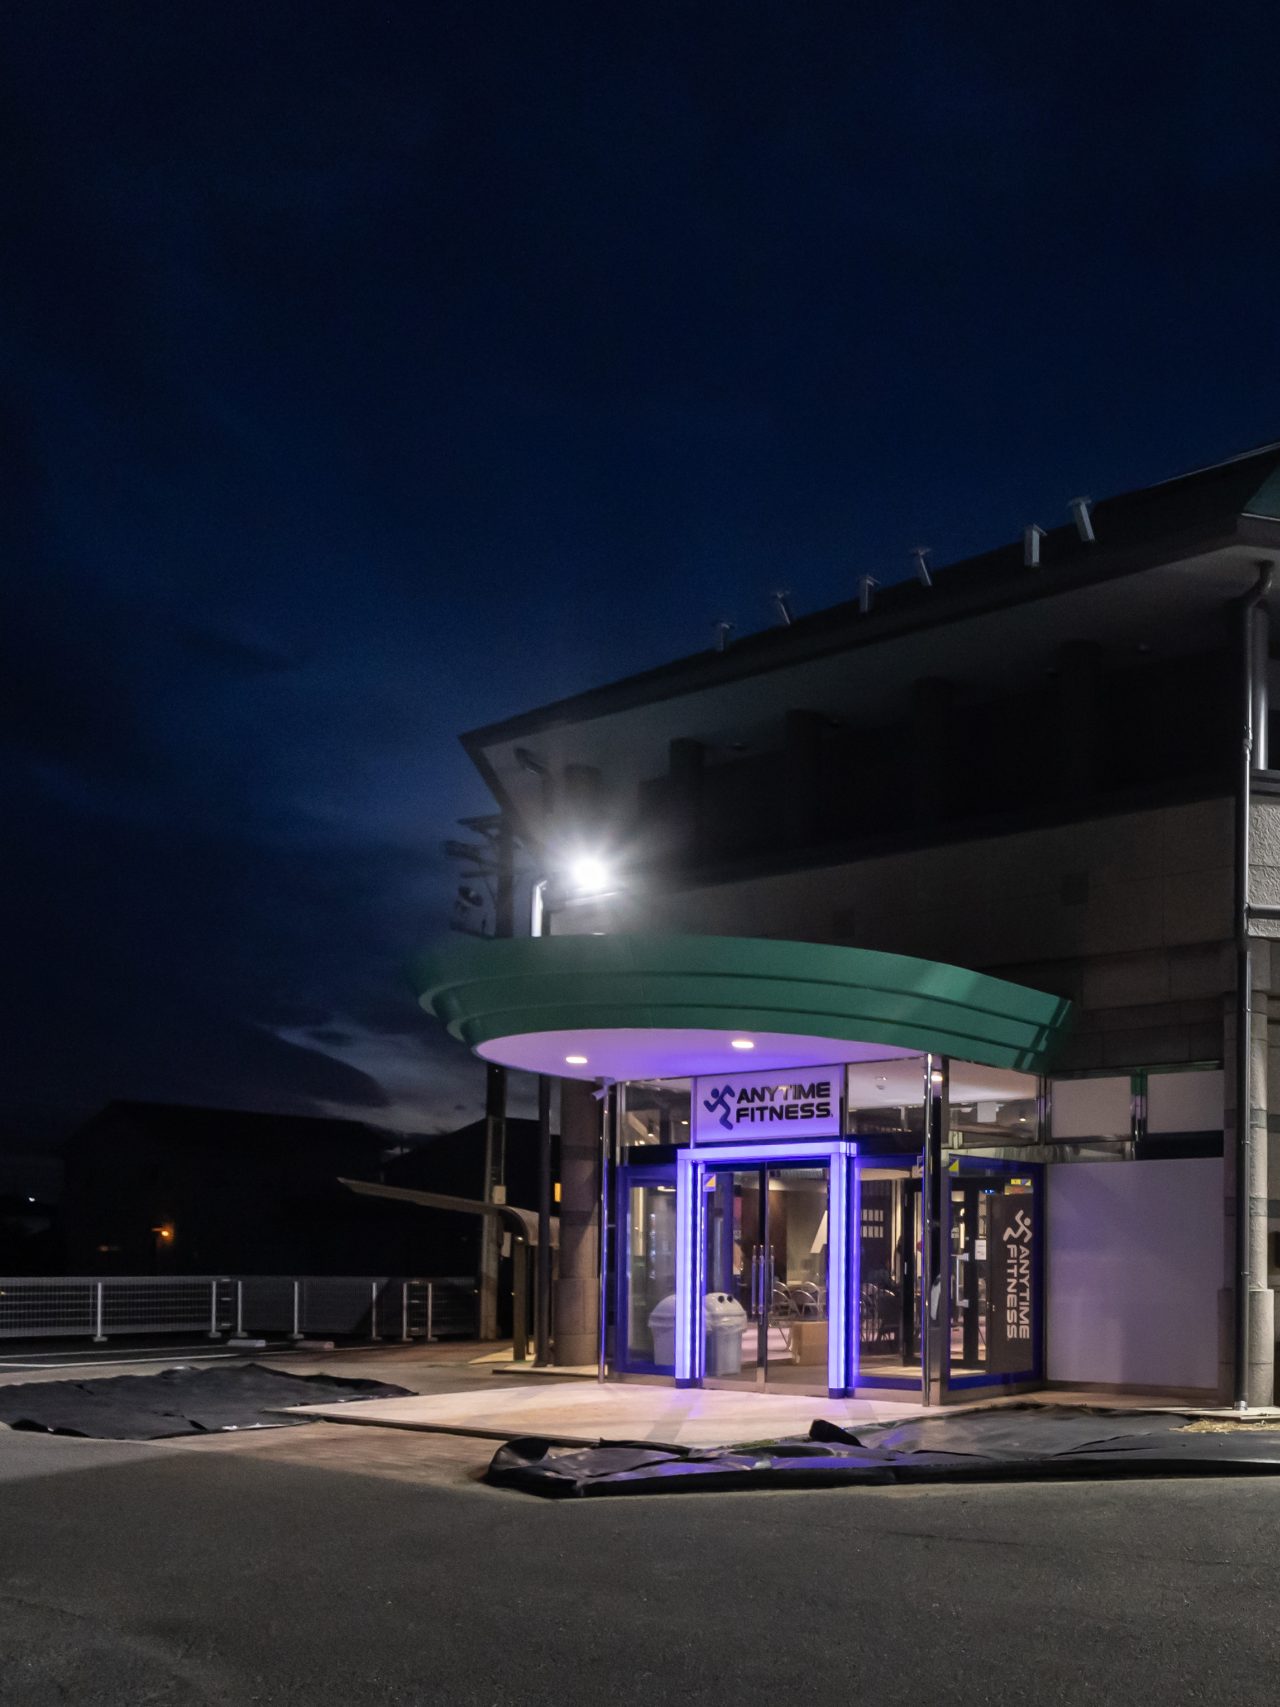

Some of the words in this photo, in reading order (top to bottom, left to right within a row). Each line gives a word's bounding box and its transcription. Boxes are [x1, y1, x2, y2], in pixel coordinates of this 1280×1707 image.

[735, 1102, 831, 1123] FITNESS
[736, 1082, 831, 1104] ANYTIME
[1006, 1244, 1018, 1339] FITNESS
[1019, 1245, 1030, 1339] ANYTIME
